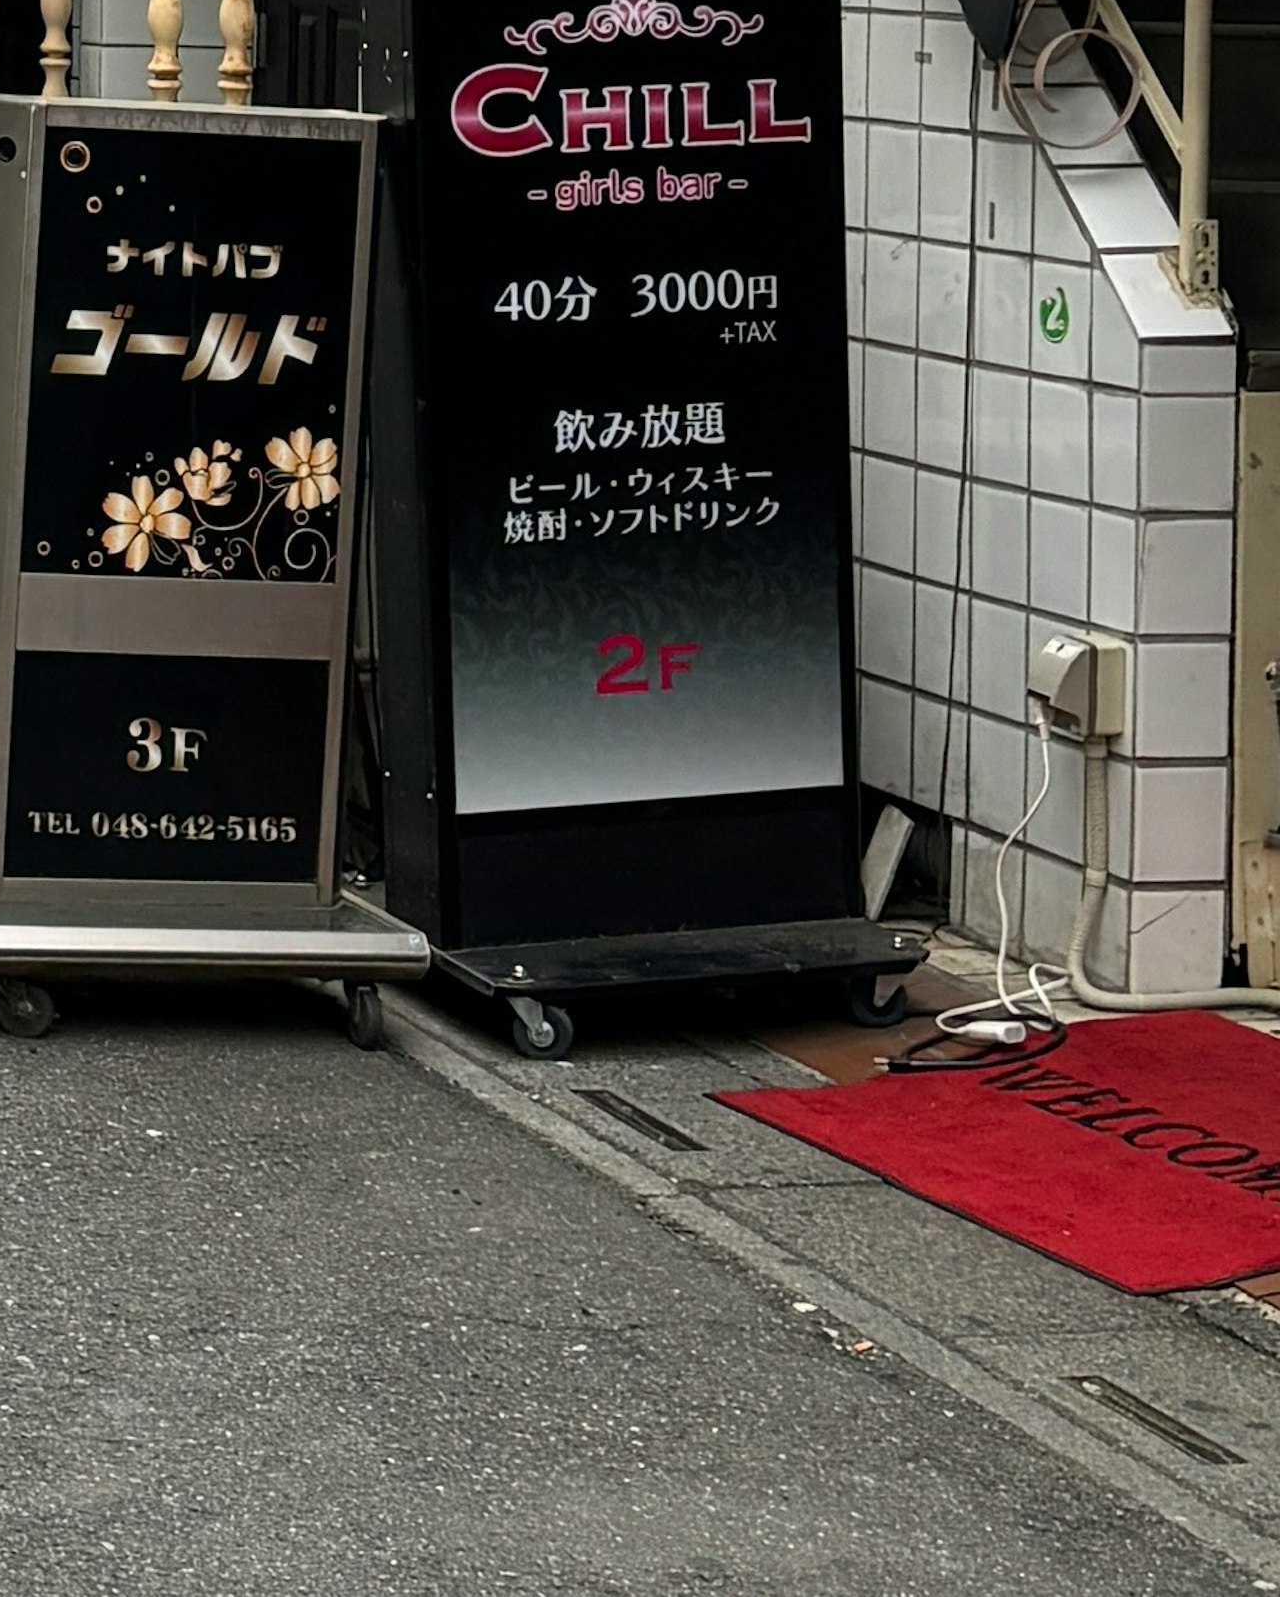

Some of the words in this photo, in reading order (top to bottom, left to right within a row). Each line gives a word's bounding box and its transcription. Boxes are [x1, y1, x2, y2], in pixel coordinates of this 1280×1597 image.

[450, 62, 812, 158] CHILL
[106, 238, 284, 279] ナイトパブ
[494, 274, 598, 322] 40分
[630, 269, 779, 319] 3000円
[49, 303, 328, 385] ゴールド
[719, 319, 778, 345] +TAX
[552, 401, 726, 454] 飲み放題
[507, 463, 775, 507] ビール・ウィスキー
[502, 497, 781, 546] 焼酎・ソフトドリンク
[593, 631, 706, 698] 2F
[126, 716, 210, 773] 3F
[28, 810, 81, 836] TEL
[91, 810, 298, 844] 048-642-5165
[978, 1061, 1280, 1204] WELCOM
